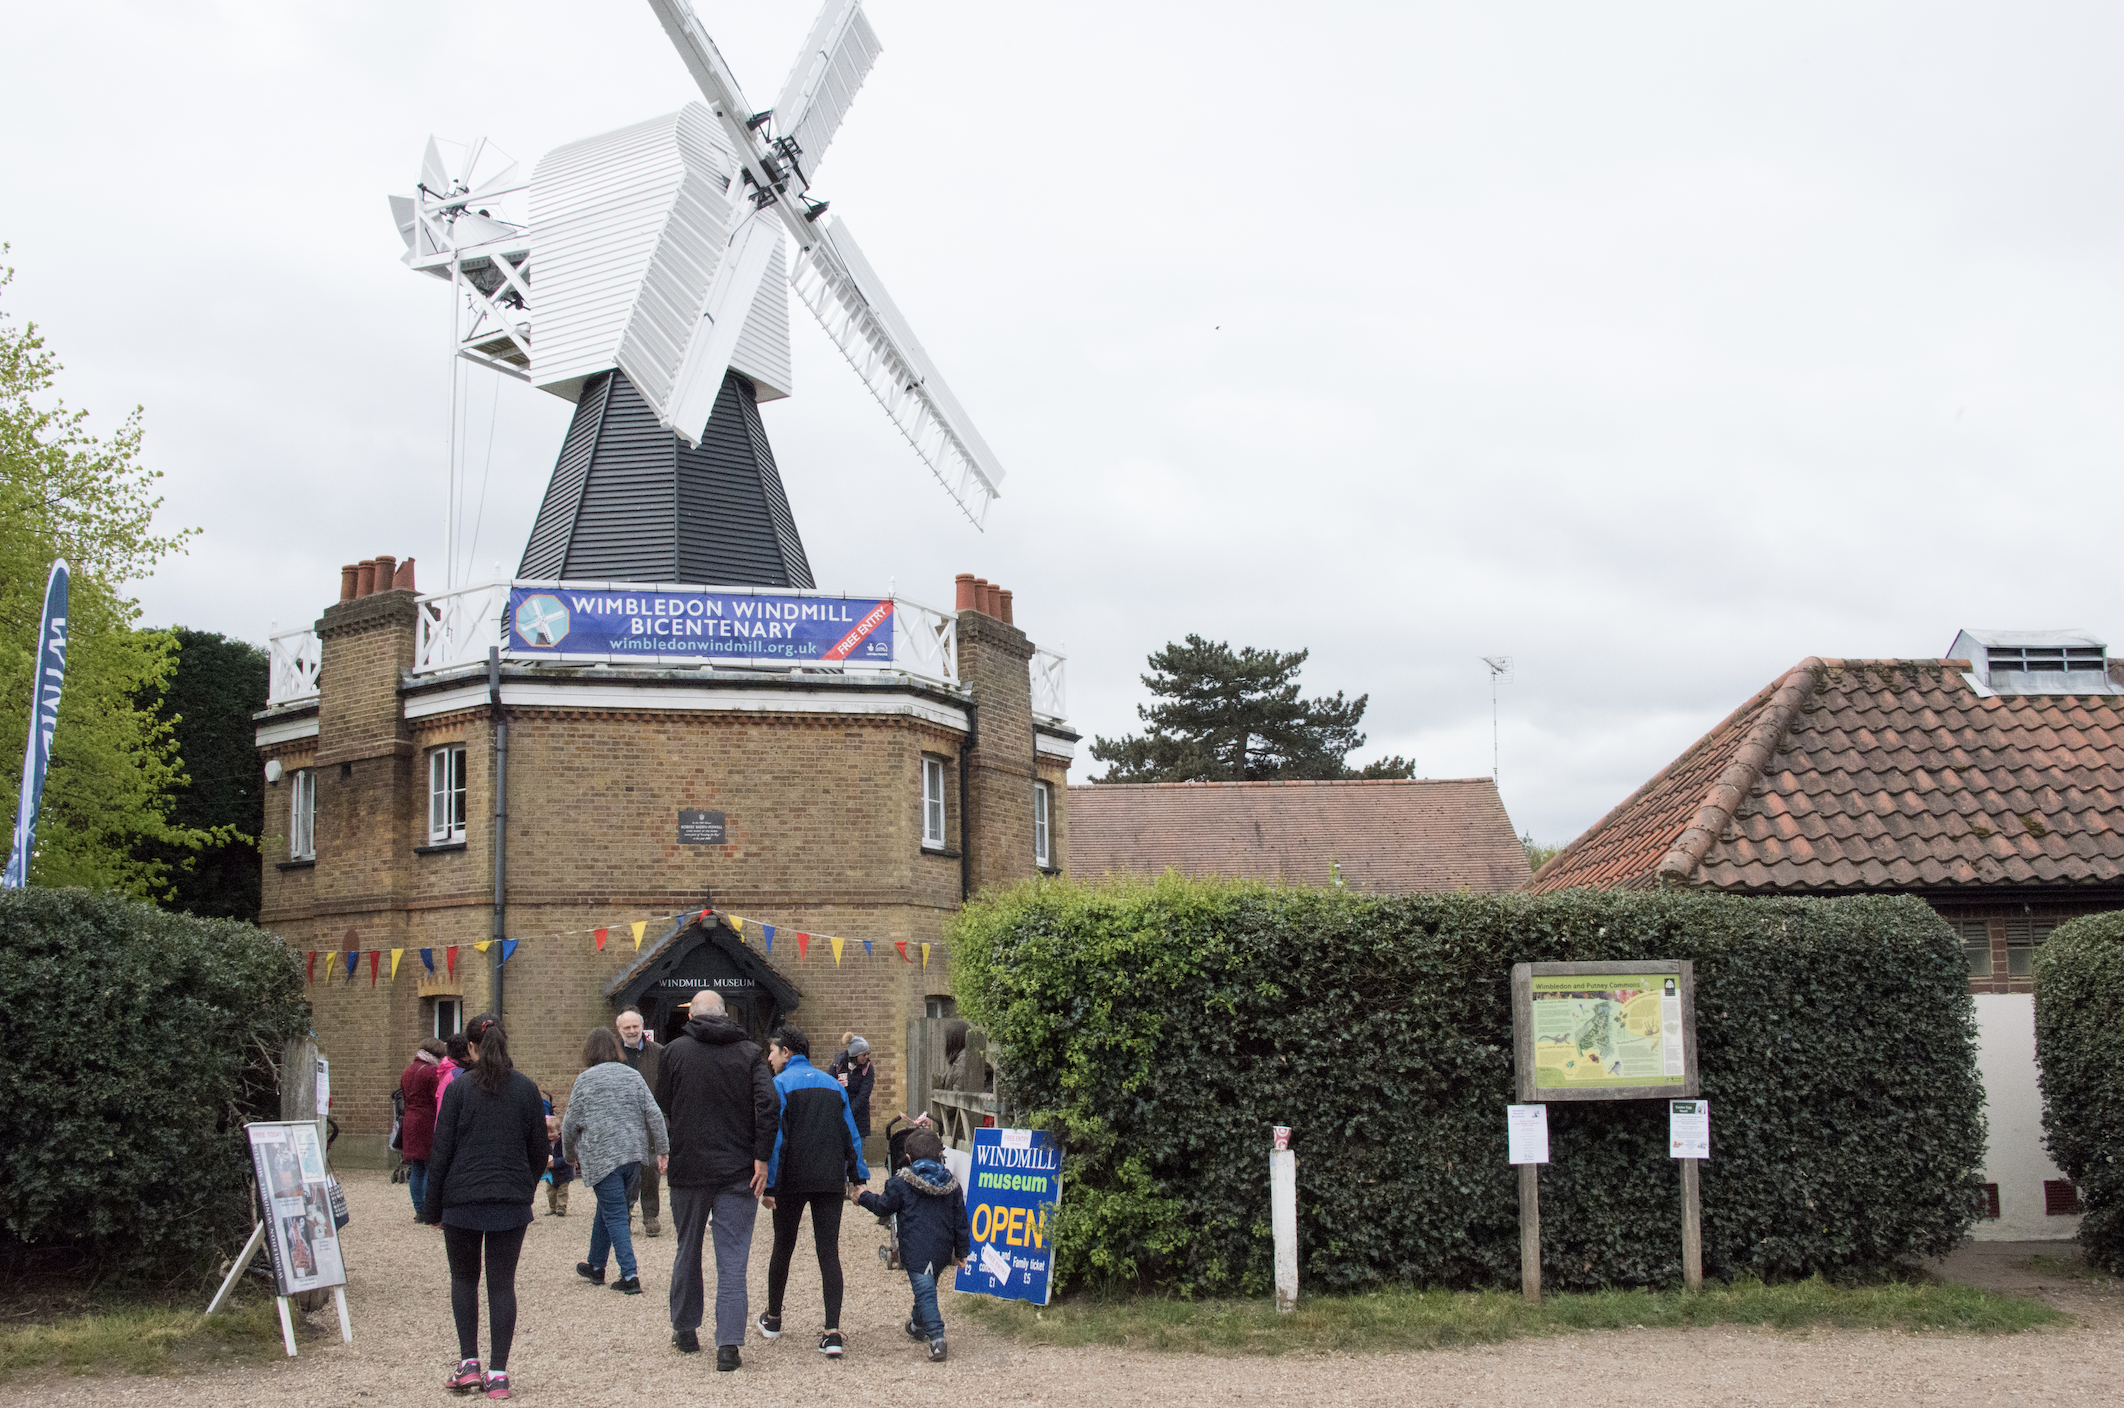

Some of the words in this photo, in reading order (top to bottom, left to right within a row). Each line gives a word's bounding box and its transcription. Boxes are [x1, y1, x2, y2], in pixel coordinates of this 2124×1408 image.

[571, 597, 722, 617] WIMBLEDON
[732, 601, 853, 622] WINDMILL
[631, 618, 797, 639] BICENTENARY
[837, 632, 860, 655] FREE
[857, 606, 886, 635] ENTRY
[610, 637, 817, 657] wimbledonwindmill.org.uk
[659, 978, 710, 987] WINDMILL
[713, 978, 755, 987] MUSEUM
[1586, 982, 1608, 990] Putney
[976, 1144, 1057, 1170] WINDMILL
[978, 1172, 1048, 1193] museum
[261, 1182, 272, 1224] WINDMILL
[971, 1203, 1045, 1249] OPEN
[270, 1228, 283, 1279] WIMBLEDON
[986, 1250, 996, 1263] FREE
[995, 1260, 1007, 1276] ENTRY
[1012, 1256, 1029, 1271] Family
[1029, 1258, 1045, 1272] ticket
[964, 1264, 972, 1276] £2
[1023, 1272, 1031, 1285] £5
[989, 1276, 996, 1288] £1
